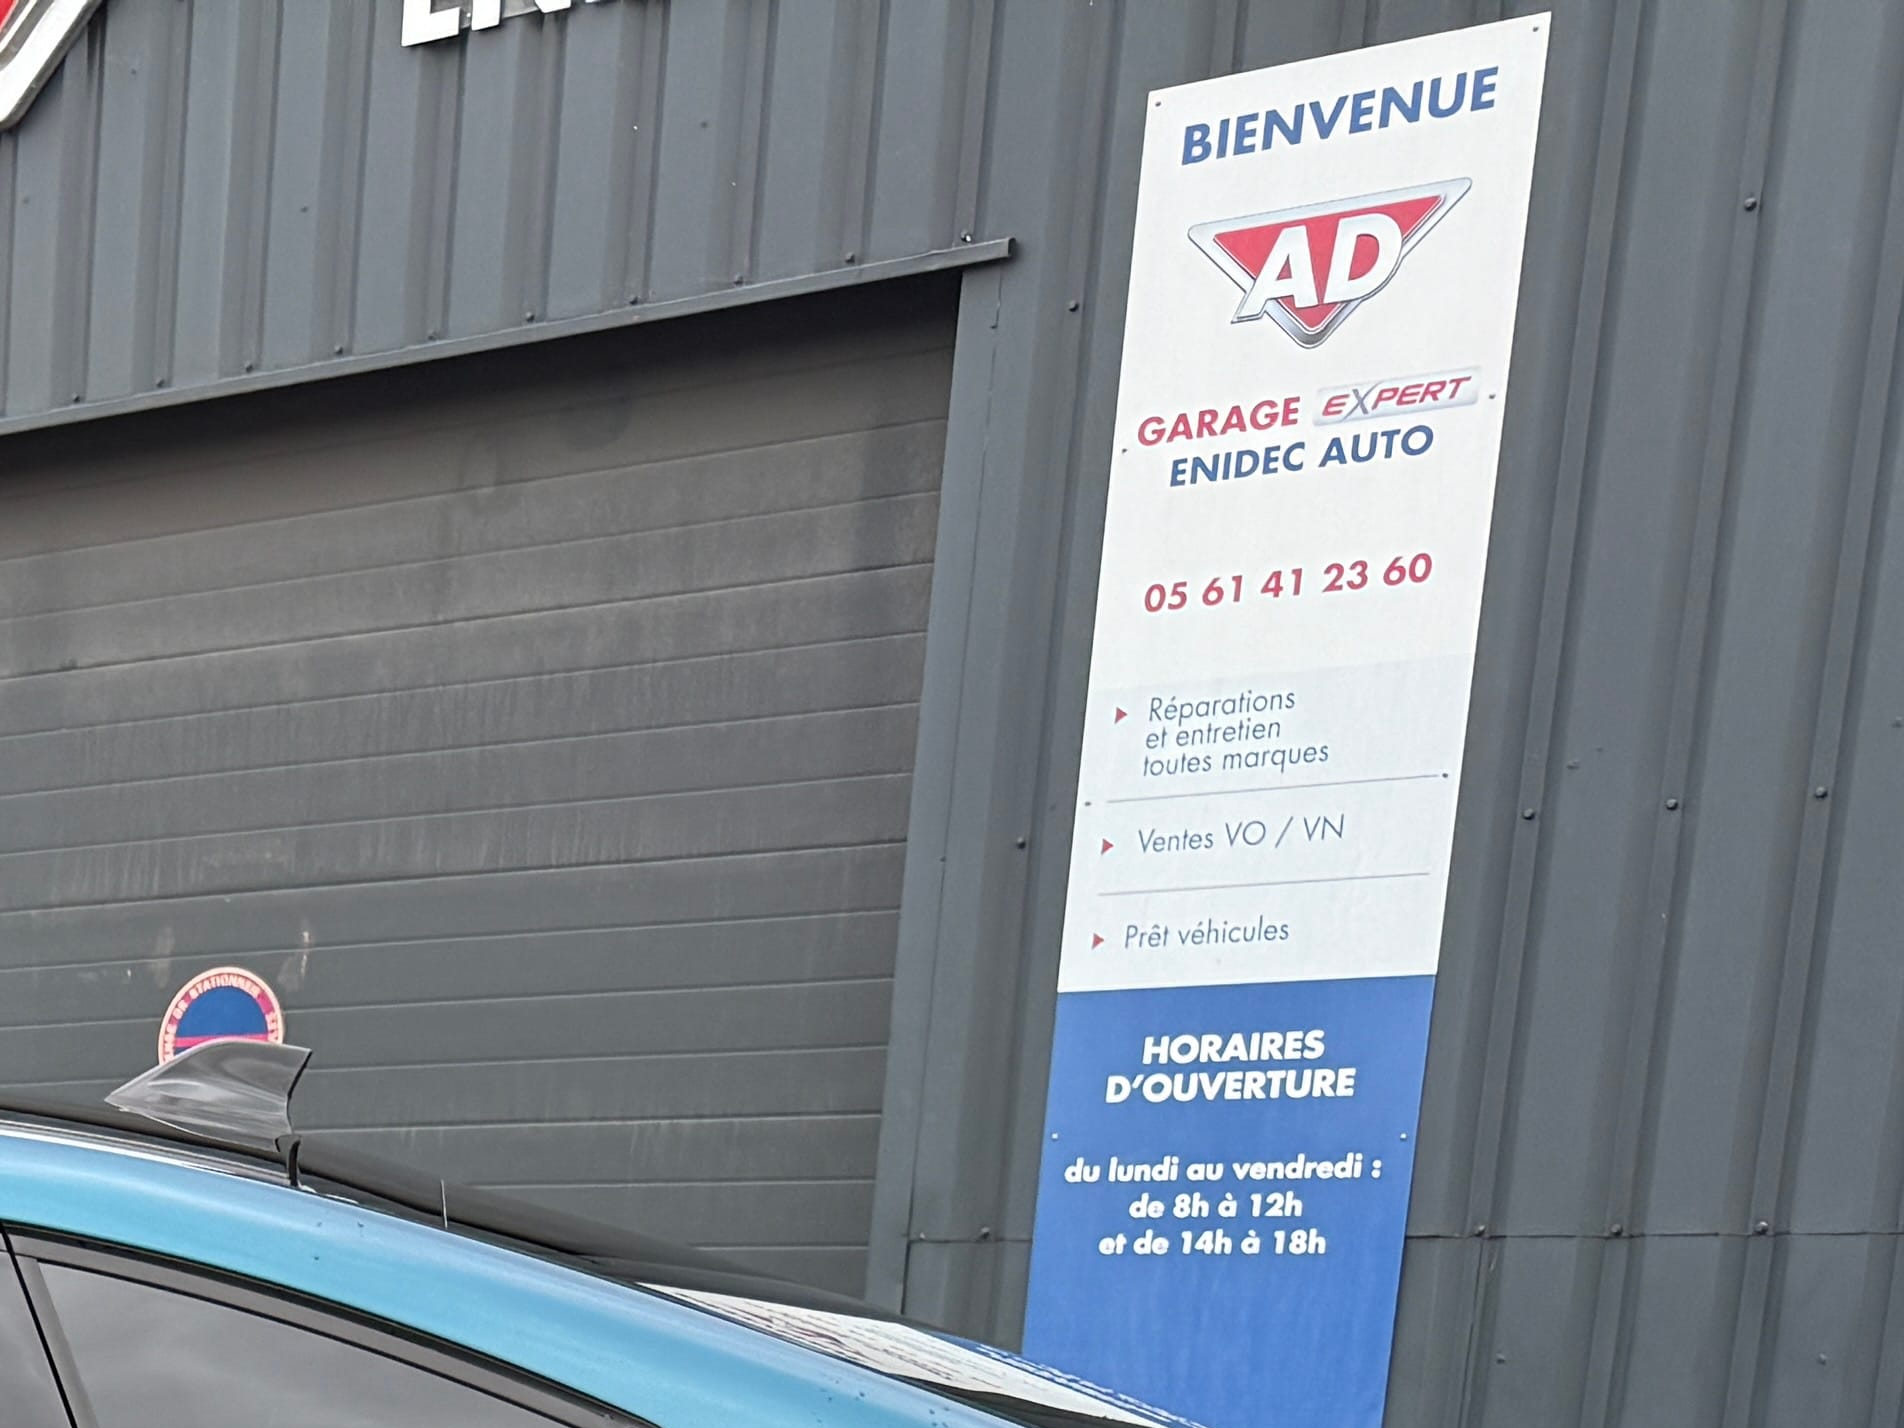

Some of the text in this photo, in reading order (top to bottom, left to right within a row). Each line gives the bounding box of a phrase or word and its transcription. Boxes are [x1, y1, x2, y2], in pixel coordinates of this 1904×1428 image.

[1180, 65, 1499, 167] BIENVENUE
[1231, 210, 1405, 325] AD
[1136, 374, 1472, 448] GARAGE EXPERT
[1169, 423, 1434, 488] ENIDEC AUTO
[1143, 552, 1433, 613] 05 61 41 23 60
[1148, 688, 1296, 723] Réparations
[1144, 716, 1282, 749] et entretien
[1142, 742, 1330, 777] toutes marques
[1138, 824, 1215, 855] Ventes
[1223, 818, 1266, 848] VO
[1303, 813, 1346, 842] VN
[1123, 917, 1290, 950] Prêt véhicules
[1141, 1029, 1326, 1066] HORAIRES
[1104, 1067, 1357, 1104] D'OUVERTURE
[1064, 1158, 1101, 1184] du
[1108, 1155, 1179, 1183] lundi
[1186, 1161, 1224, 1182] au
[1232, 1153, 1364, 1181] vendredi
[1129, 1189, 1303, 1218] de 8h à 12h
[1098, 1226, 1326, 1255] et de 14h à 18h
